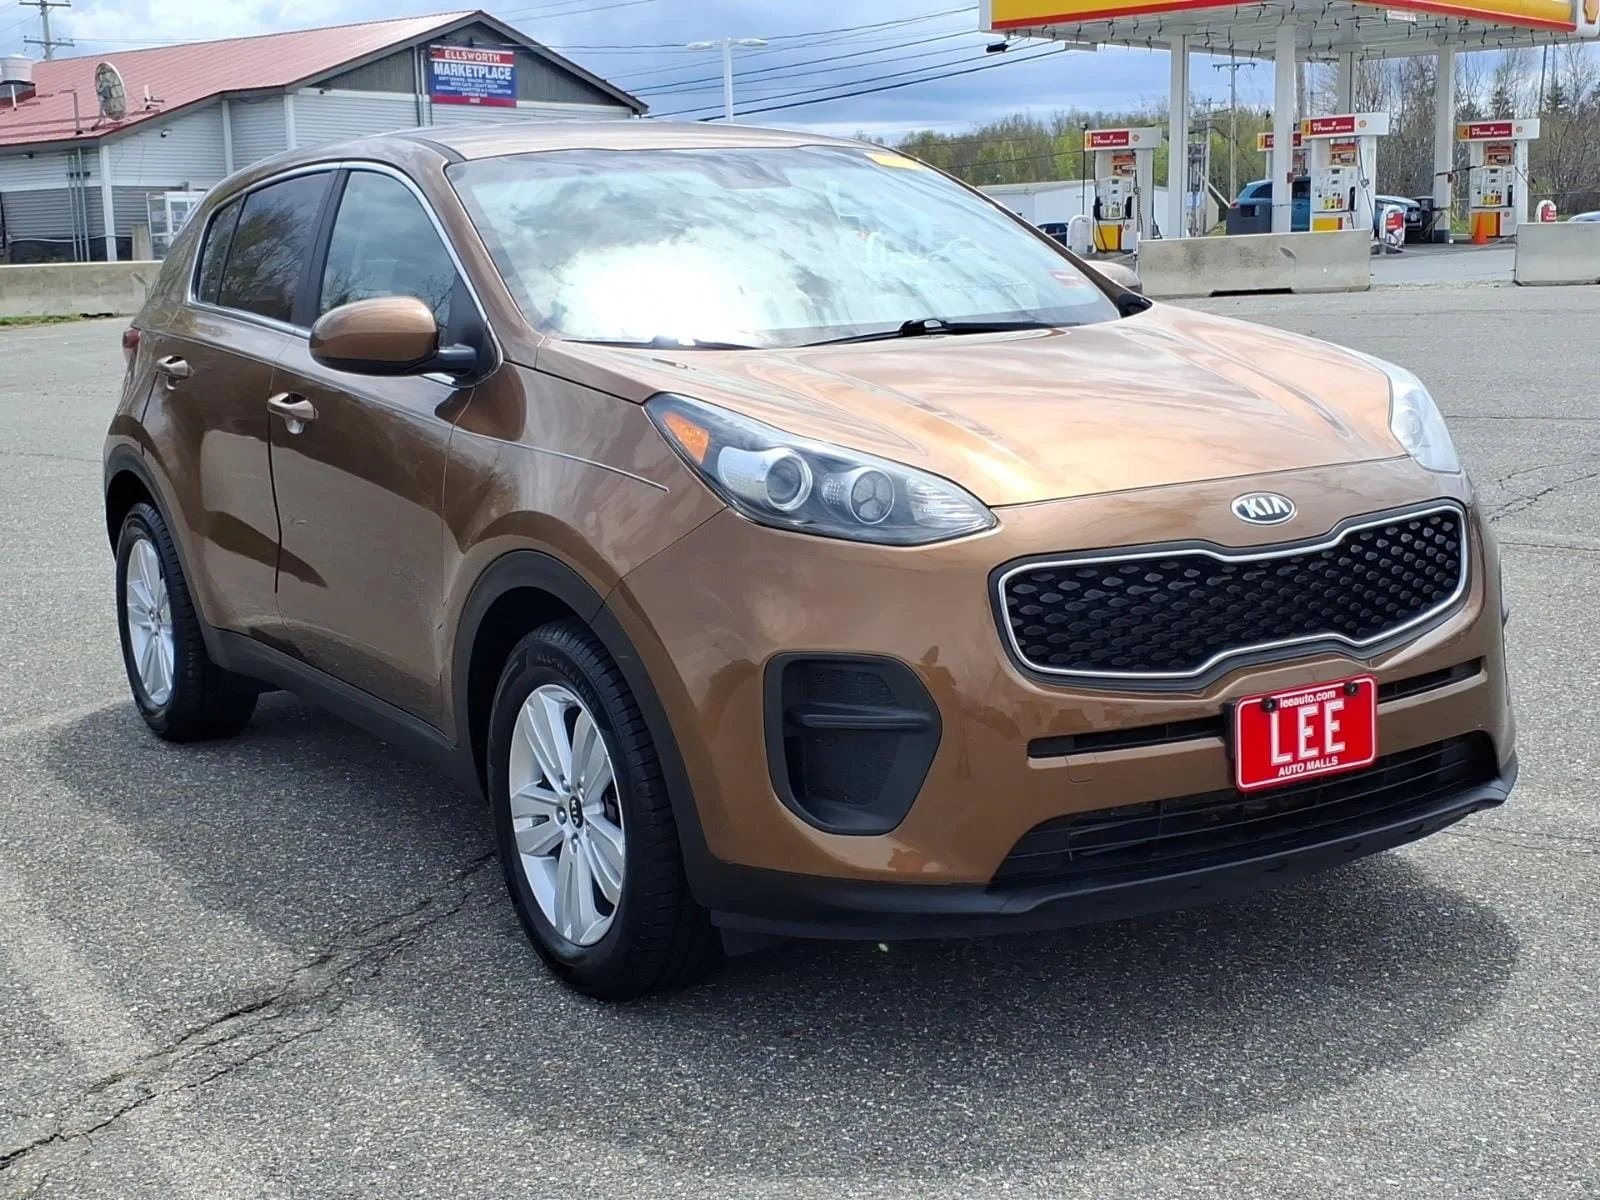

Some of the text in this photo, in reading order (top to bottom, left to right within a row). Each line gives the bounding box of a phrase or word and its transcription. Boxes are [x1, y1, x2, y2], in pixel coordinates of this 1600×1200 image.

[444, 50, 501, 62] ELLSWORTH
[433, 62, 512, 80] MARKETPLACE
[1238, 496, 1290, 518] KIA
[1279, 690, 1336, 708] leeauto.com
[1270, 698, 1346, 767] LEE
[1278, 756, 1339, 777] AUTO MALLS
[570, 799, 580, 826] KIA
